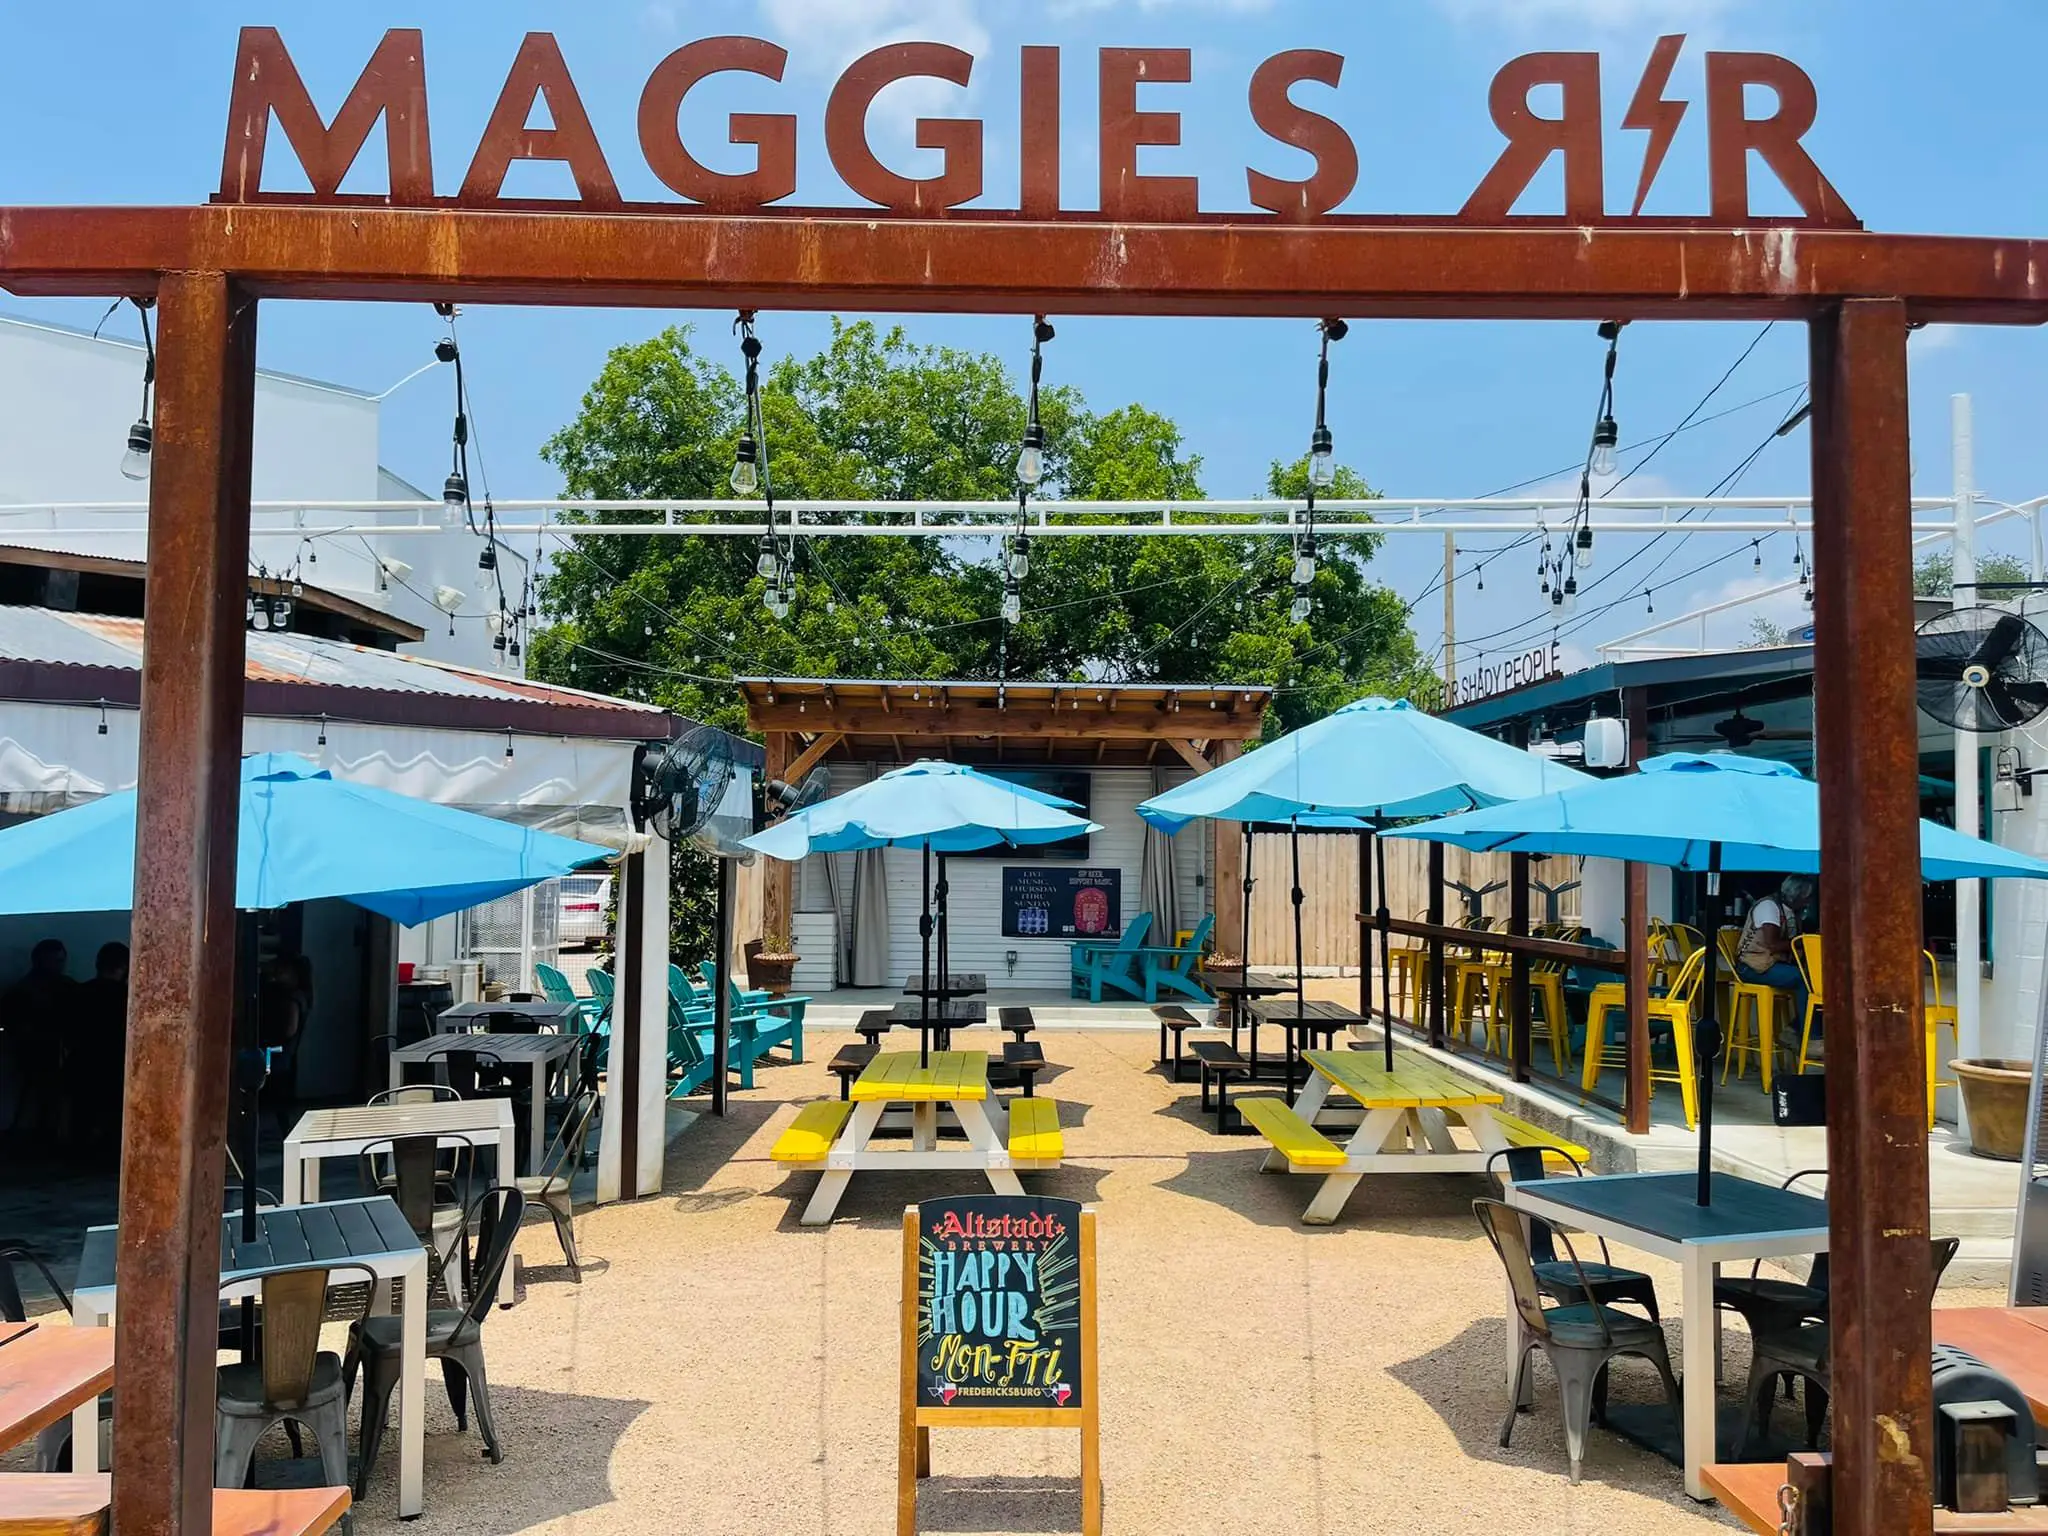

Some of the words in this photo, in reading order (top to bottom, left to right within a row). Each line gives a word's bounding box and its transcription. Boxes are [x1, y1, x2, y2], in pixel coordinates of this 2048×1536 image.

[220, 27, 1359, 215] MAGGIES
[1438, 680, 1459, 712] FOR
[1462, 664, 1501, 703] SHADY
[1504, 643, 1560, 688] PEOPLE
[937, 1211, 1057, 1240] Altstadt
[948, 1241, 1049, 1251] BREWERY
[933, 1251, 1036, 1297] HAPPY
[931, 1291, 1036, 1341] HOUR
[931, 1334, 1063, 1387] Mon-Fri
[957, 1387, 1042, 1397] FREDERICKSBURG
